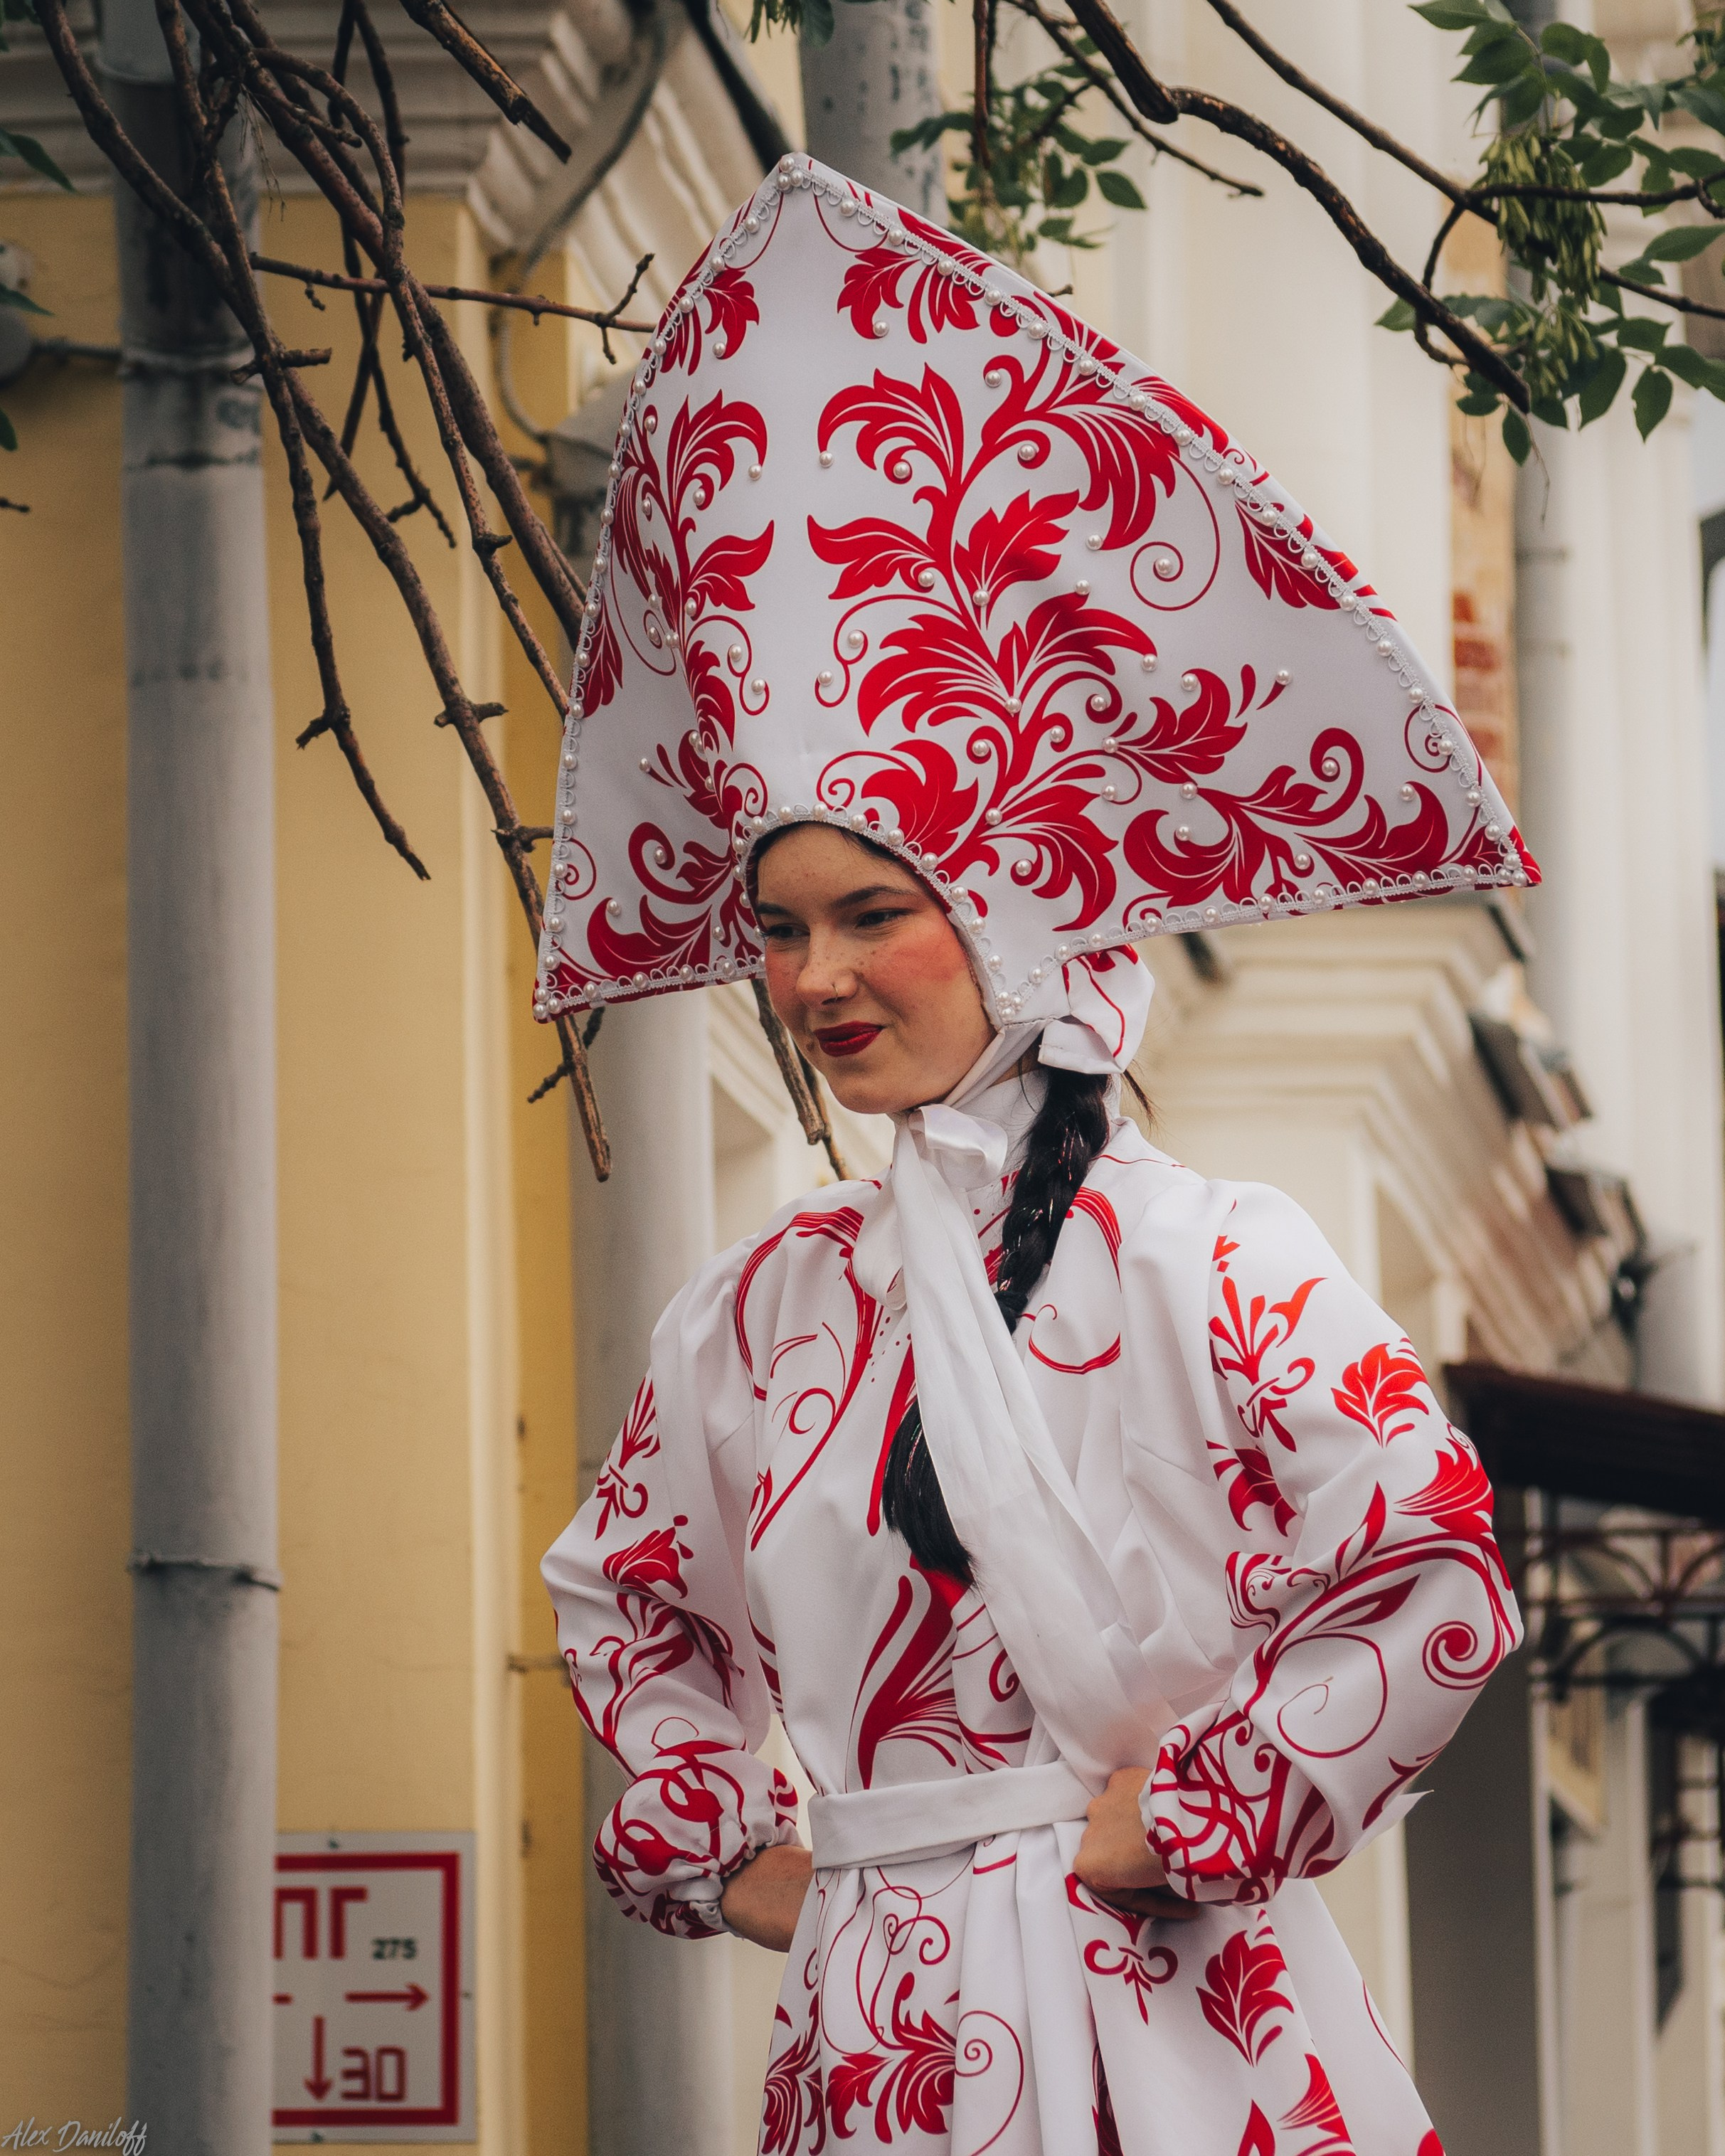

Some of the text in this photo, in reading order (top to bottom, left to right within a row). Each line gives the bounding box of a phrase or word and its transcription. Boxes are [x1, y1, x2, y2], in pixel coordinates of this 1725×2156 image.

[274, 1887, 367, 1959] ПГ
[372, 1938, 417, 1960] 275
[341, 2047, 406, 2101] 30
